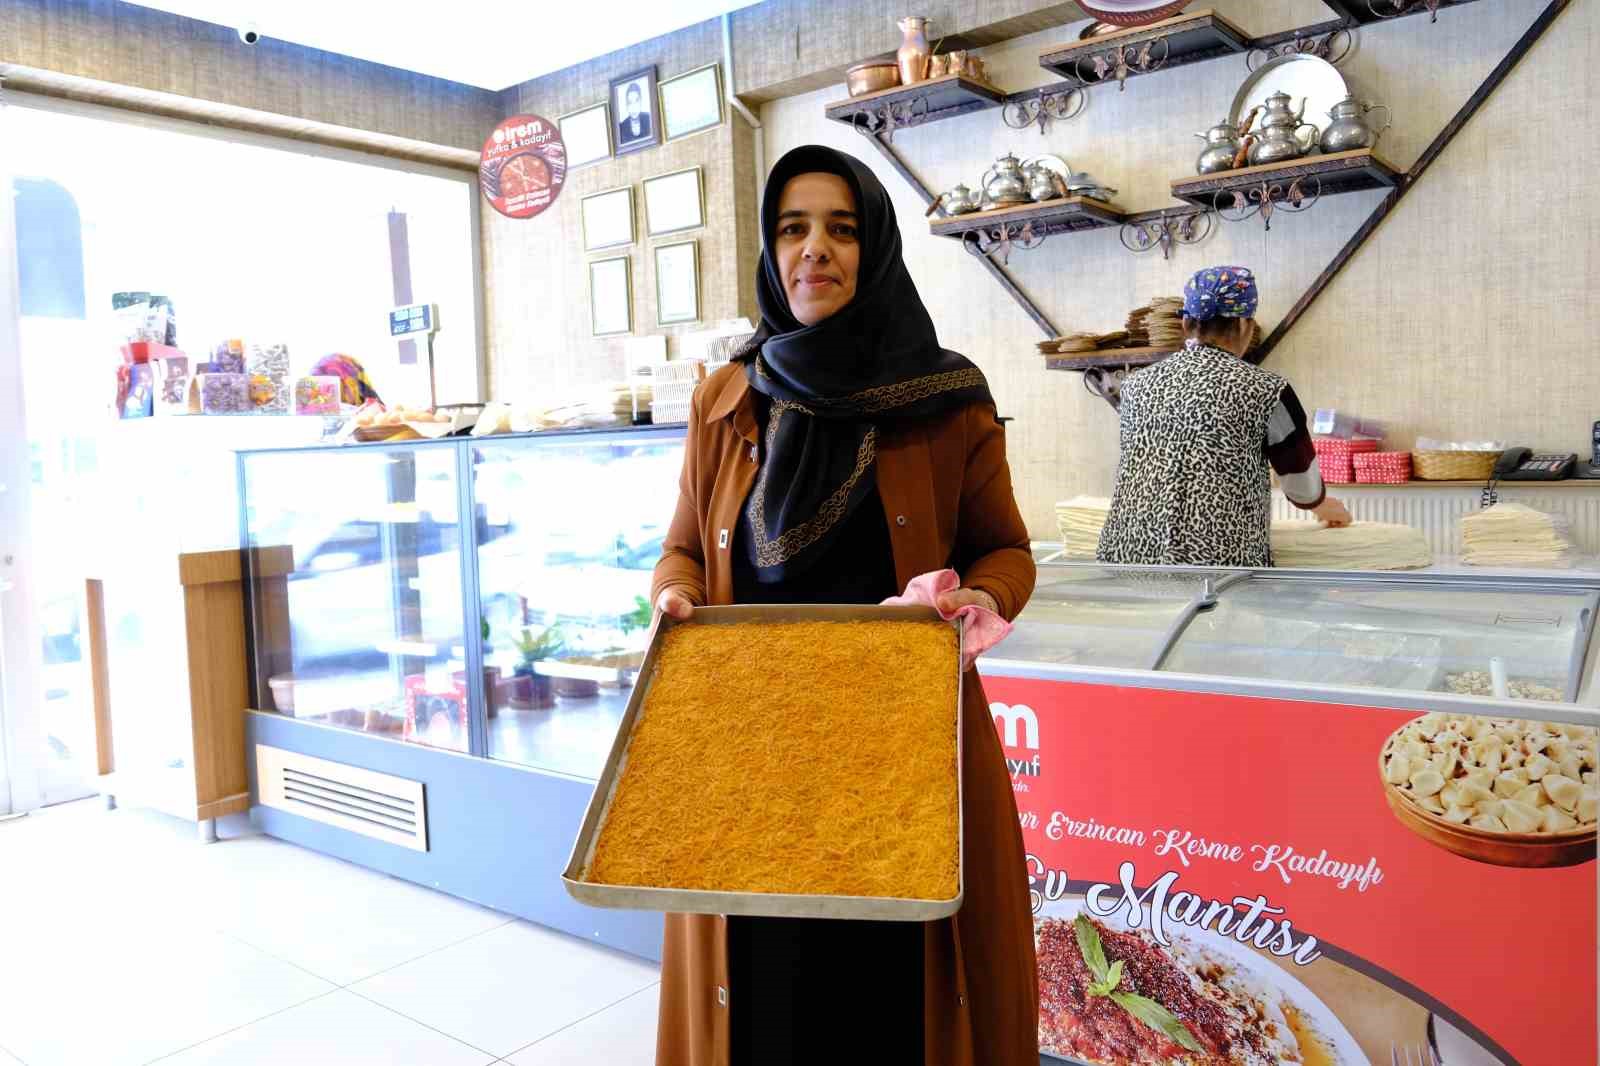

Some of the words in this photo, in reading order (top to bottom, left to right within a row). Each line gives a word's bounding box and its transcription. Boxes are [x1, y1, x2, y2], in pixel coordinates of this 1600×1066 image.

[1045, 811, 1147, 848] Erzincan
[1152, 829, 1244, 868] Kesme
[1086, 860, 1322, 966] Mantısı
